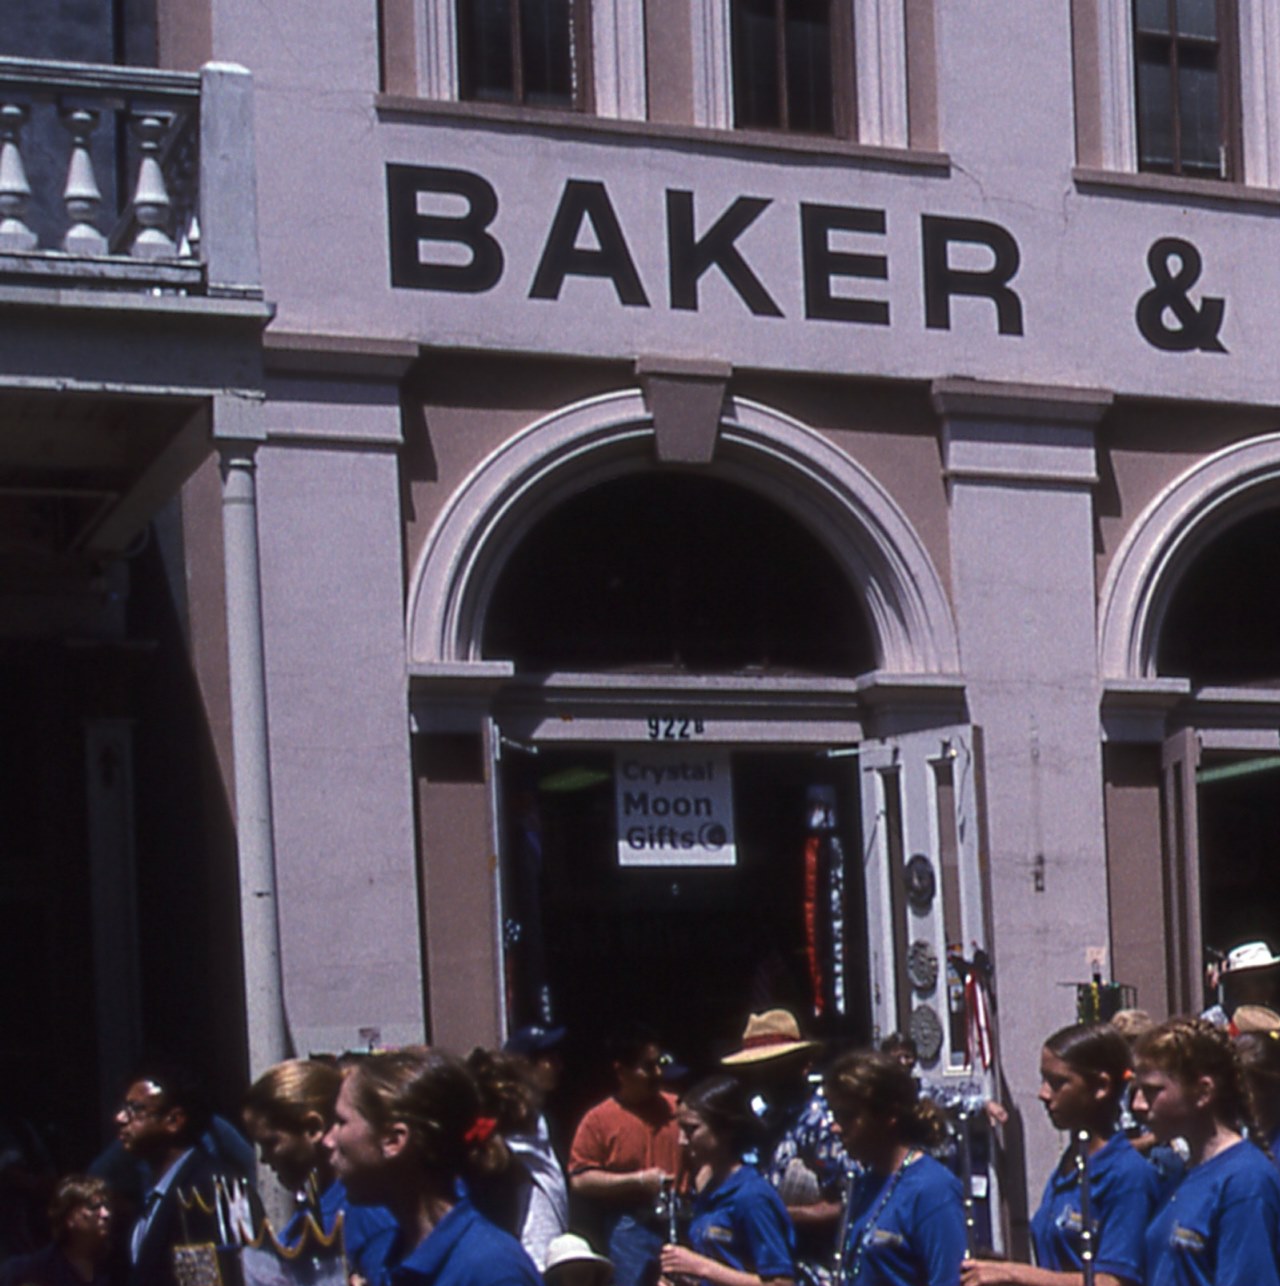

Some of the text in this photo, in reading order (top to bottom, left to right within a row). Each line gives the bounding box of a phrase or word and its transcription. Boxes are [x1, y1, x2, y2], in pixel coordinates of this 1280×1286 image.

[385, 161, 1024, 337] BAKER
[1134, 236, 1230, 354] &
[622, 760, 715, 785] Crystal
[623, 791, 712, 816] Moon
[626, 825, 695, 850] Gifts
